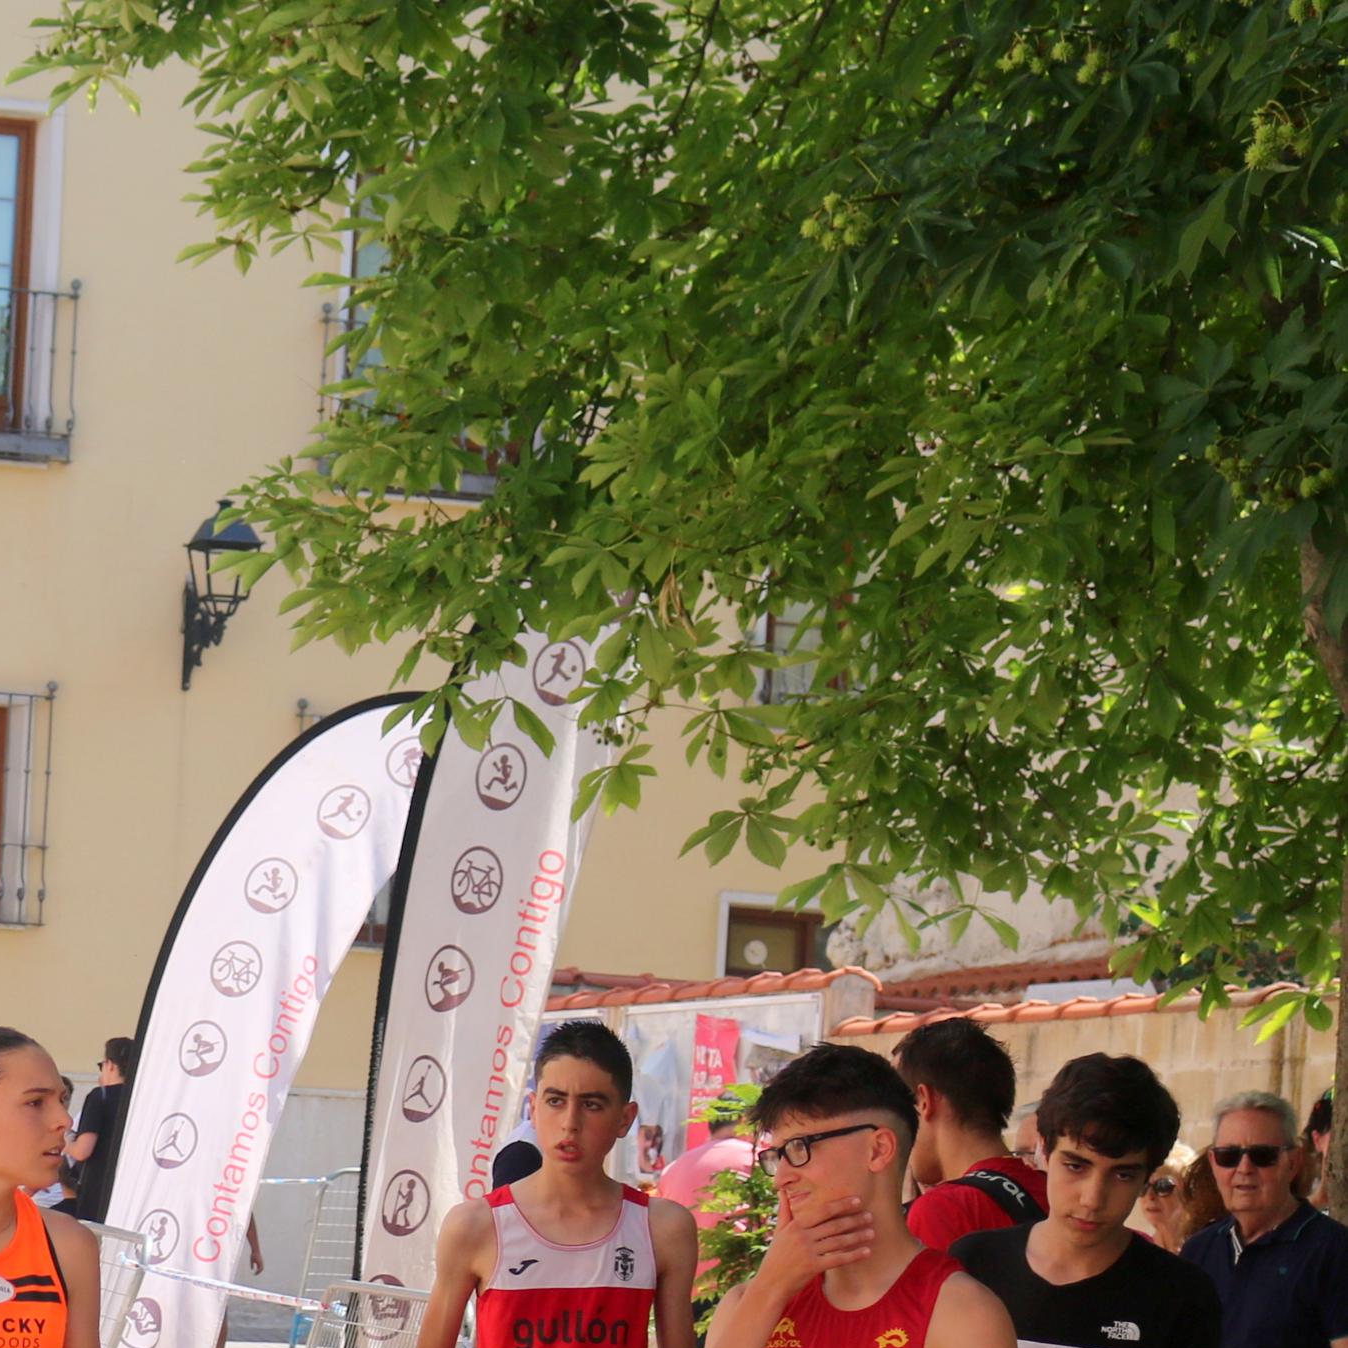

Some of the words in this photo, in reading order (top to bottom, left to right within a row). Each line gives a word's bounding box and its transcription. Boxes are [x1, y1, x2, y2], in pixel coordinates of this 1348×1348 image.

[192, 1092, 266, 1264] Contamos
[253, 954, 319, 1081] Contigo
[463, 1024, 514, 1200] ontamos
[500, 849, 568, 1009] Contigo
[1114, 1320, 1130, 1328] THE
